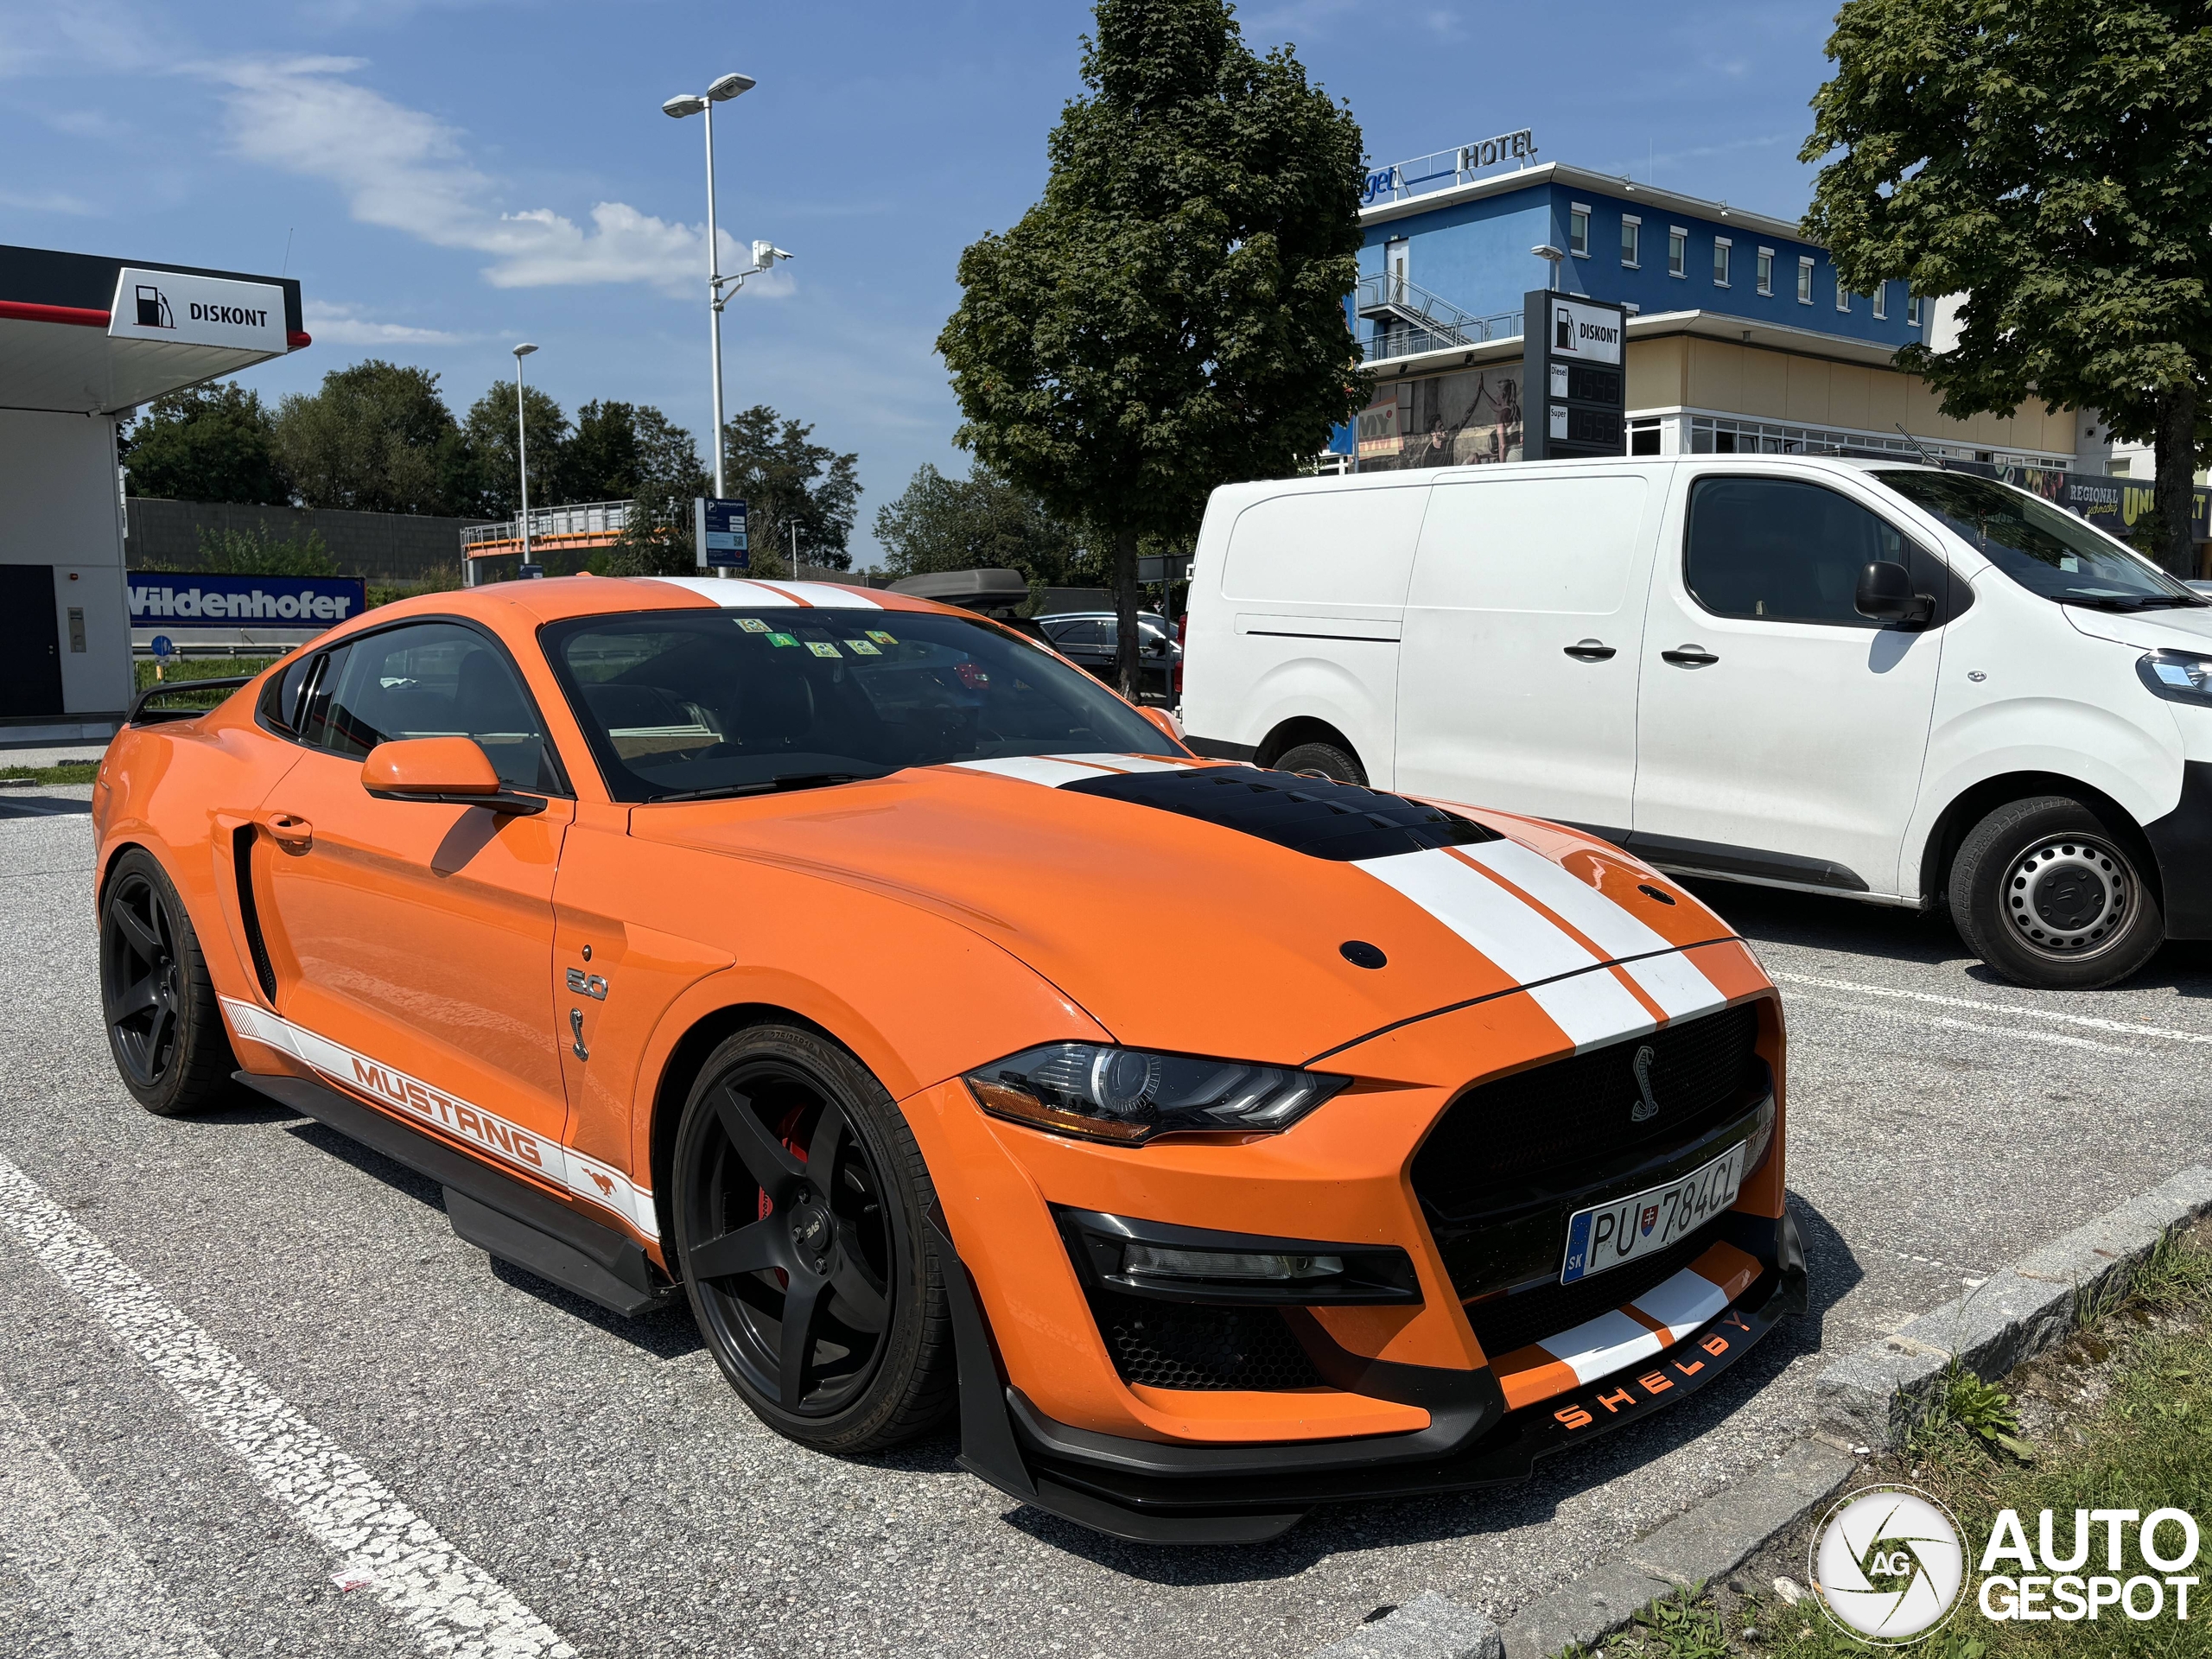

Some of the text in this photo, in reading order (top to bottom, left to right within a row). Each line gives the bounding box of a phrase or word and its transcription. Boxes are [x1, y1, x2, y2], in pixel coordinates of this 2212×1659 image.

[1462, 130, 1538, 170] HOTEL
[1363, 167, 1397, 203] get
[189, 302, 268, 327] DISKONT
[1580, 322, 1618, 345] DISKONT
[1551, 366, 1567, 377] Diesel
[1358, 413, 1389, 437] MY
[1551, 408, 1567, 419] Super
[2069, 484, 2119, 504] REGIONAL
[352, 1057, 543, 1167] MUSTANG
[1568, 1156, 1735, 1270] SK PU 784CL
[806, 1220, 820, 1239] SVE
[1554, 1309, 1751, 1430] SHELBY
